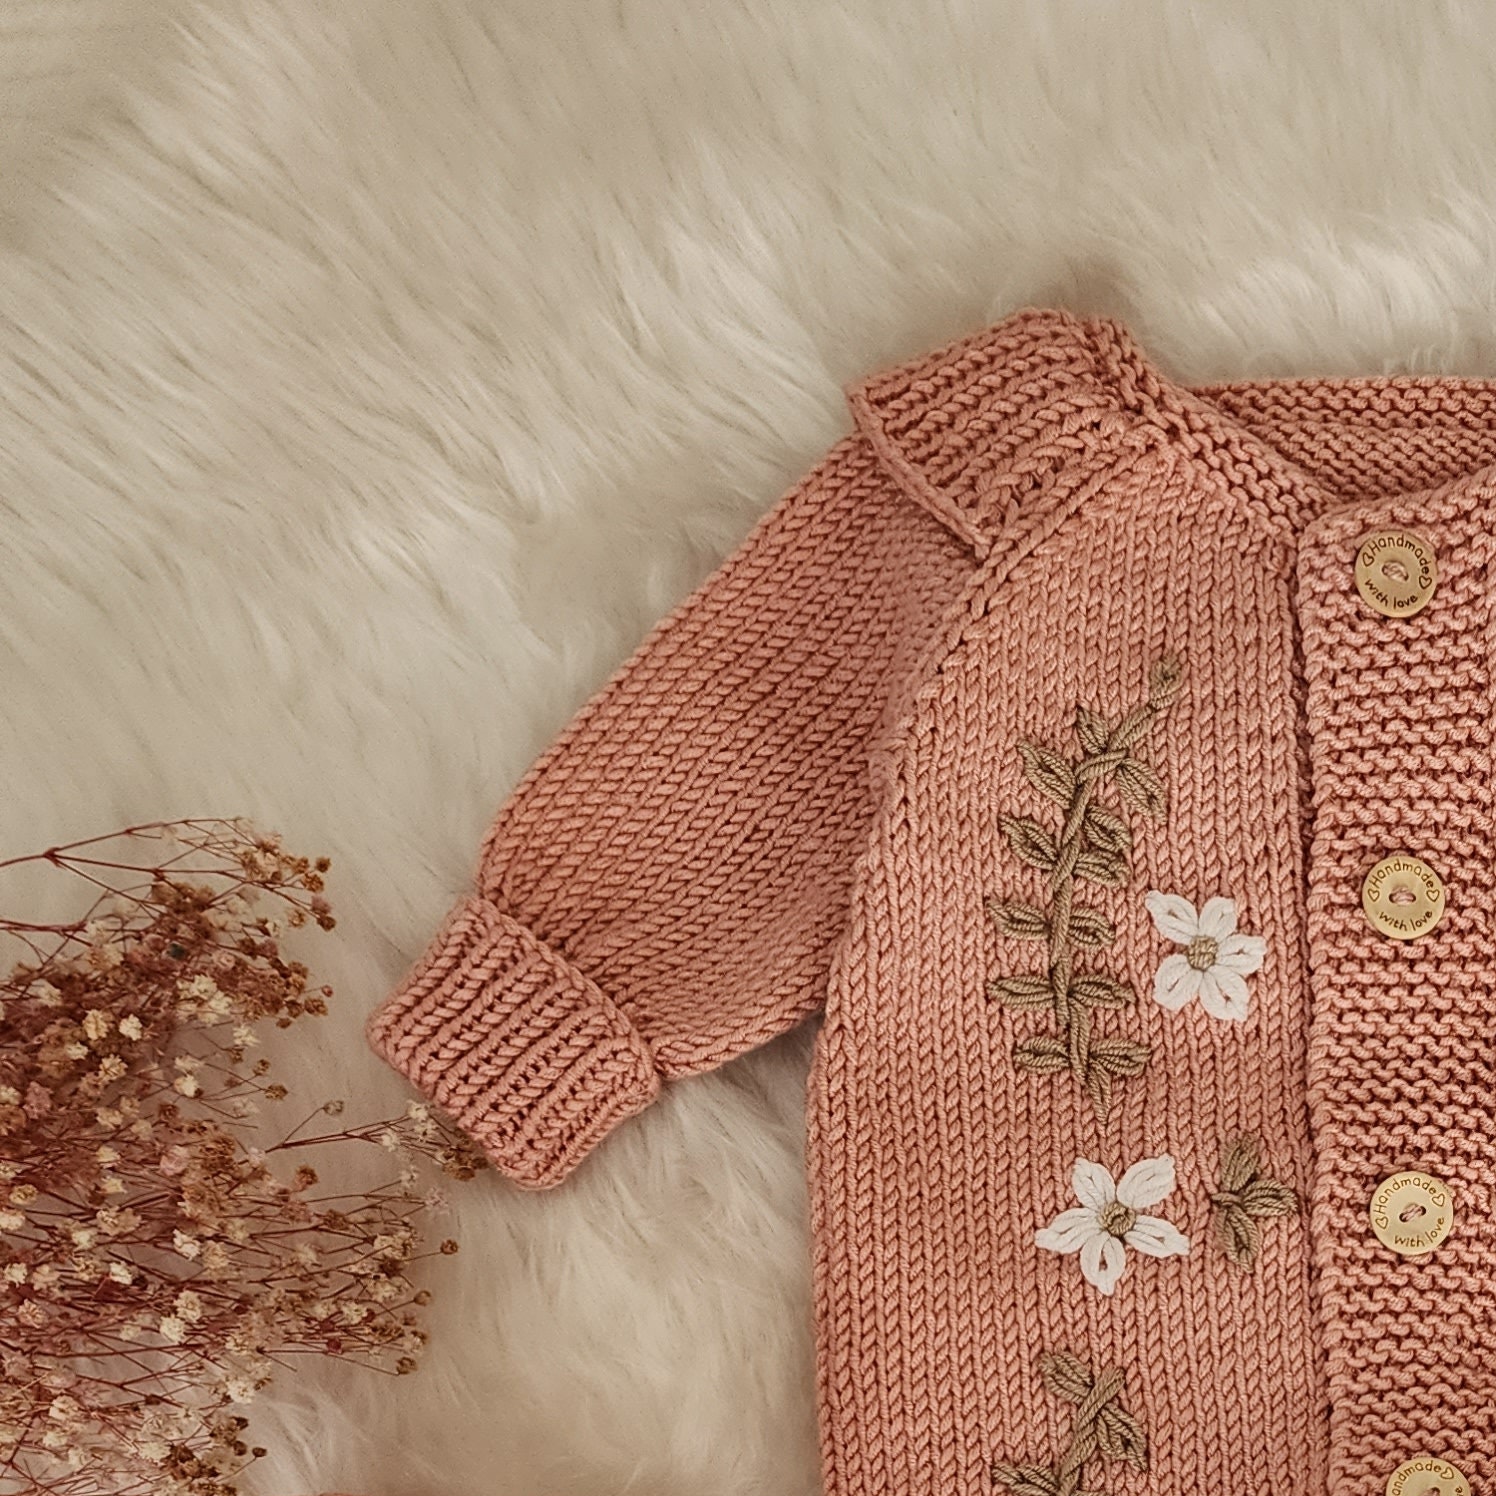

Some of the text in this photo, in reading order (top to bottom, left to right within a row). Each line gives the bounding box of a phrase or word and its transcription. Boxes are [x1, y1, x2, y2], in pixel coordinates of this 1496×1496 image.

[1368, 534, 1431, 574] Handmade
[1365, 579, 1418, 609] with love
[1369, 858, 1433, 888] Handmade
[1379, 911, 1432, 931] with love
[1374, 1177, 1436, 1214] Handmade
[1395, 1217, 1444, 1247] with love
